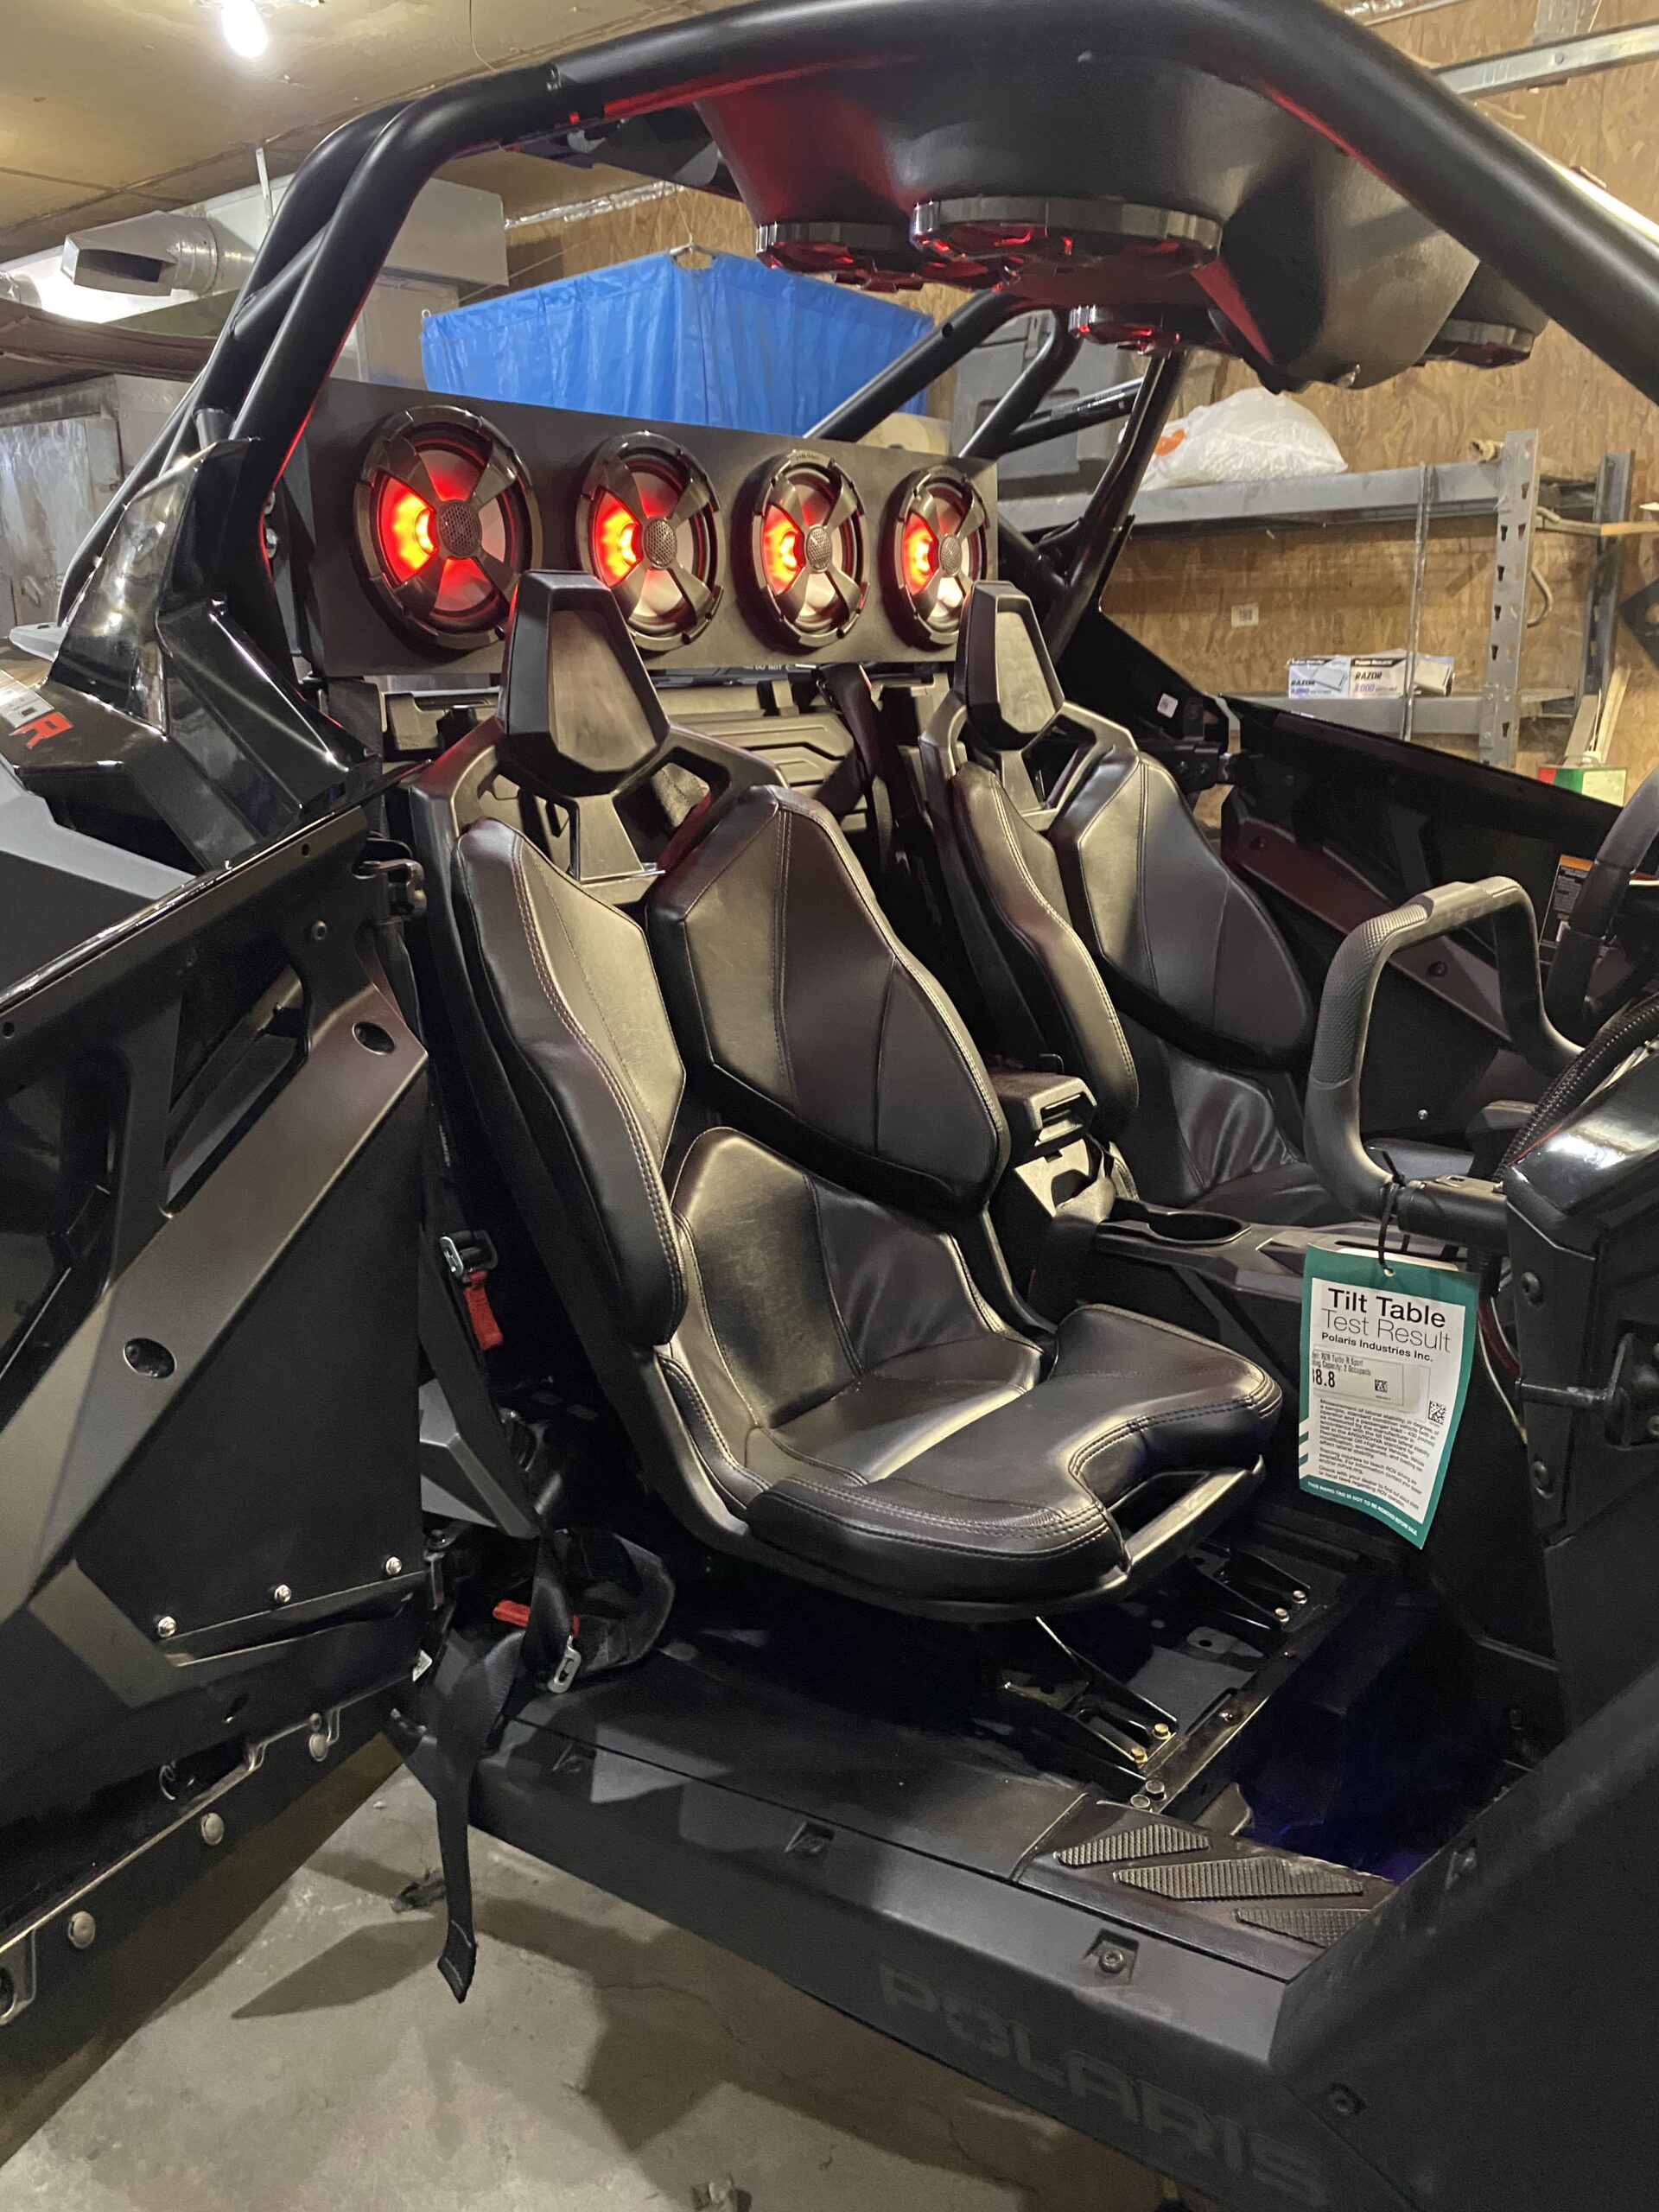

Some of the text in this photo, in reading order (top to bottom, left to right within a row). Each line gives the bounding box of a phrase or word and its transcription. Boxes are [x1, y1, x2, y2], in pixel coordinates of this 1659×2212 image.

[1355, 671, 1382, 680] RAZOR
[9, 711, 73, 749] R
[1327, 1287, 1446, 1328] Tilt Table
[1321, 1307, 1452, 1353] Test Result
[1321, 1332, 1433, 1363] Polaris Industries Inc.
[878, 1963, 1329, 2207] POLARIS
